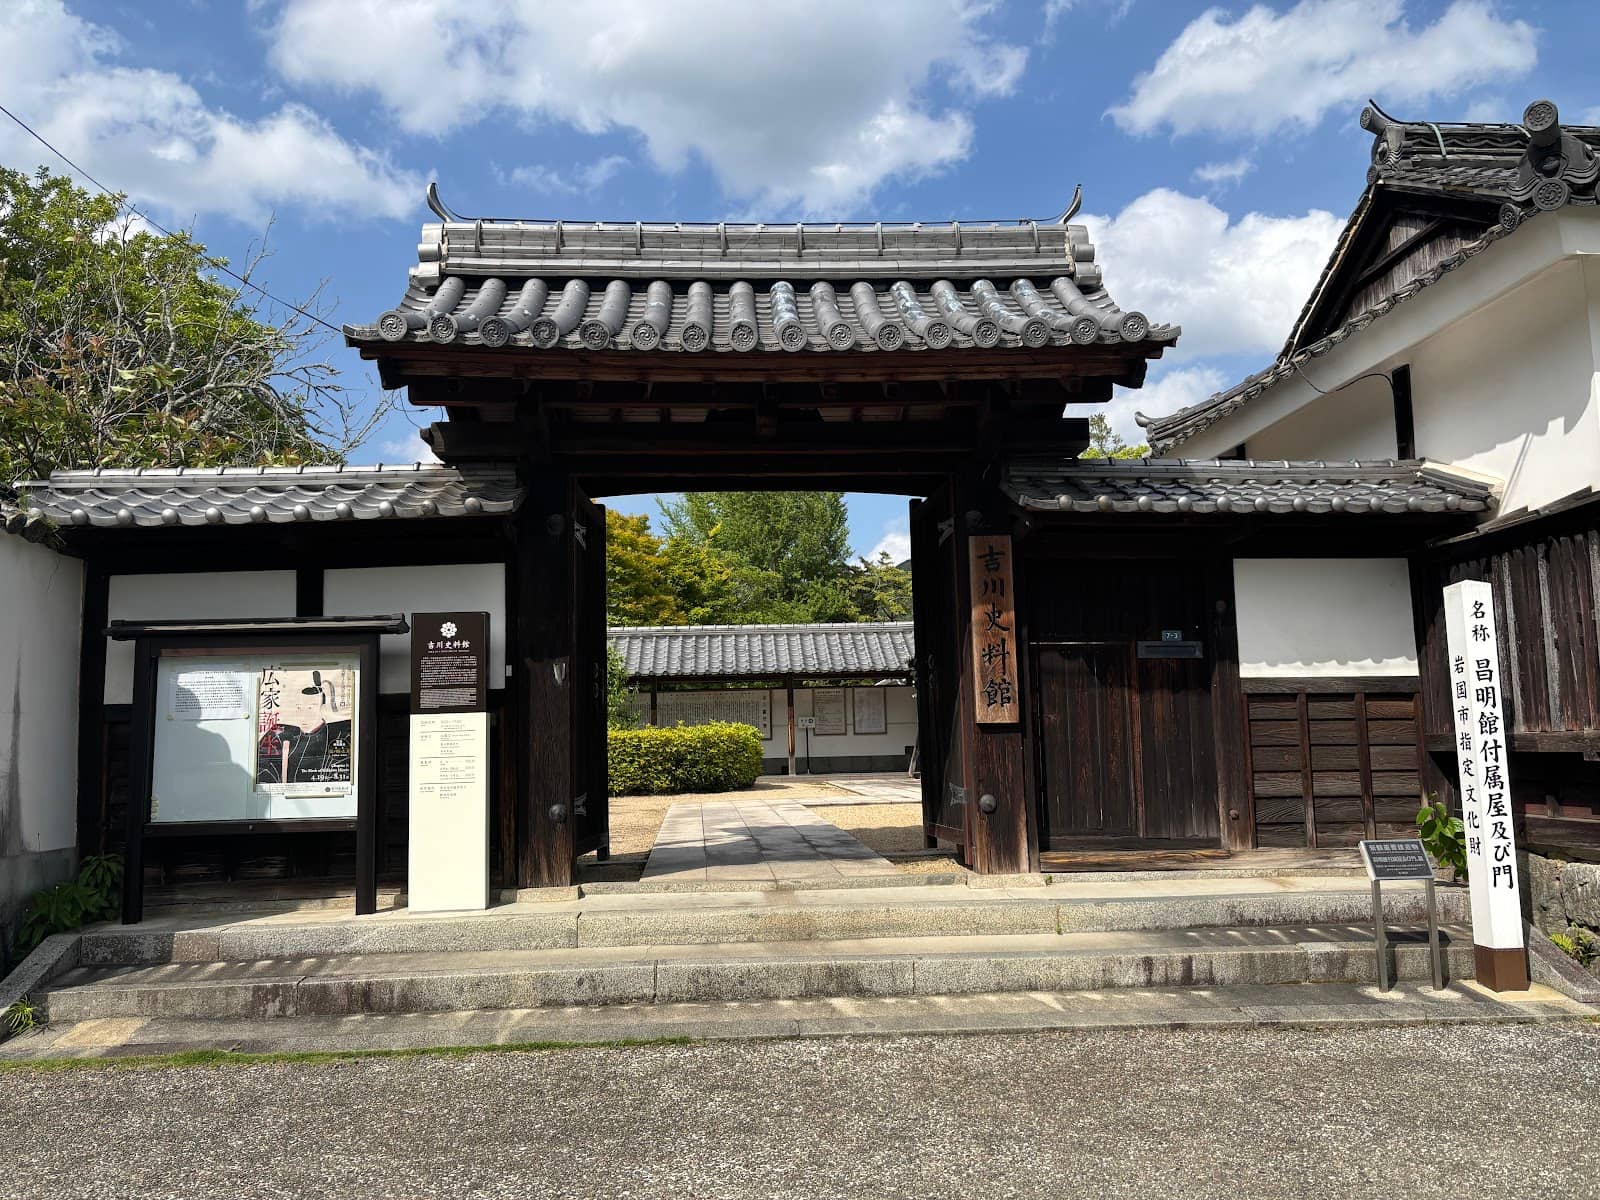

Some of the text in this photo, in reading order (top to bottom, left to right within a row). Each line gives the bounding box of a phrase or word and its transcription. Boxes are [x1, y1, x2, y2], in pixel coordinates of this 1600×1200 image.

[427, 639, 471, 650] 吉川史料館
[977, 544, 1012, 708] 吉川史料館
[258, 665, 282, 756] 広家誕生
[1453, 655, 1482, 857] 岩国市指定文化財
[1469, 600, 1514, 890] 名称 昌明館付属屋及び門
